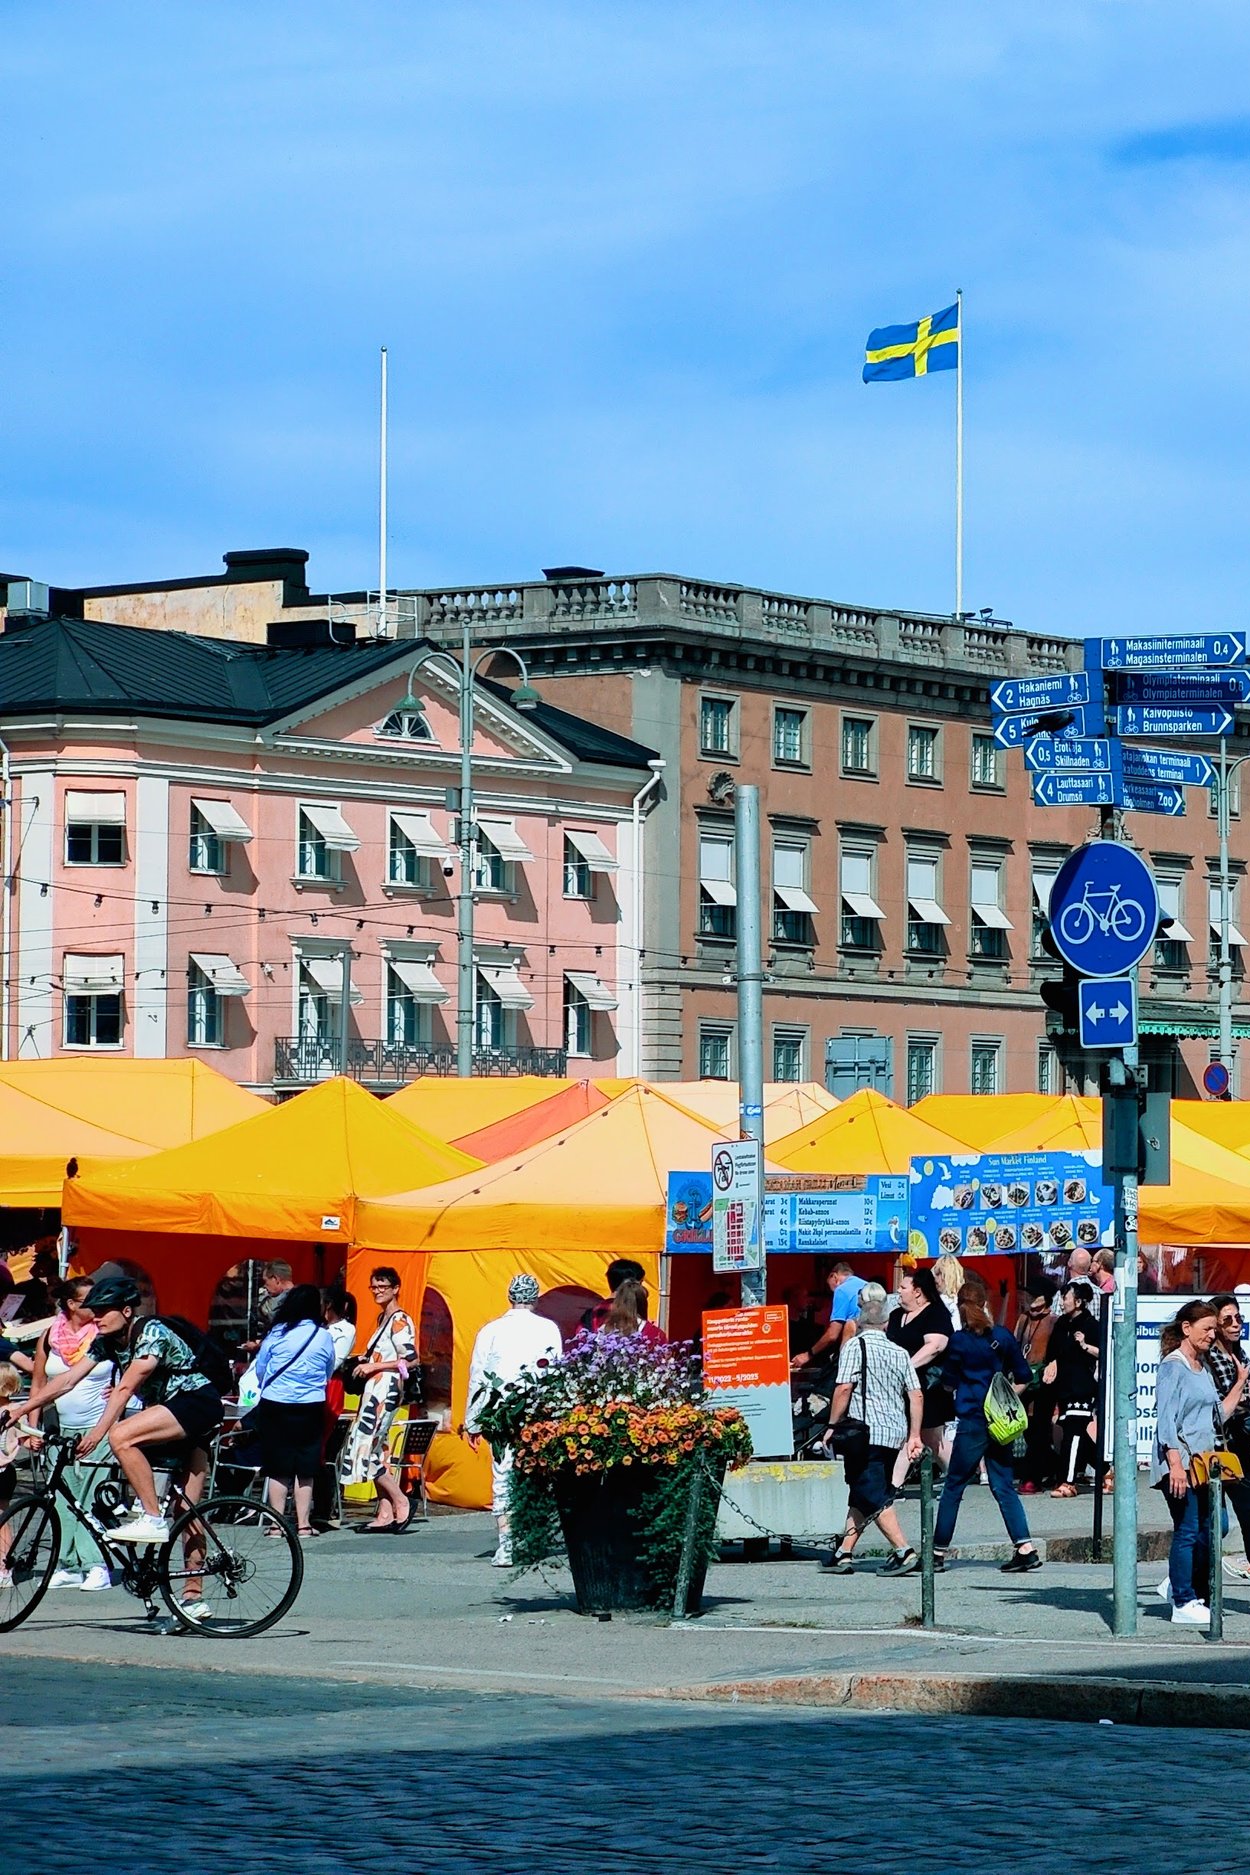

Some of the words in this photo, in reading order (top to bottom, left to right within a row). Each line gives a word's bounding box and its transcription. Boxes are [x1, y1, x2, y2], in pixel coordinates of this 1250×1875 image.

[1126, 637, 1205, 651] Makasiiniterminaali
[1214, 641, 1229, 656] 0,4
[1126, 653, 1208, 666] Magasinsterminalen
[1018, 678, 1063, 694] Hakaniemi
[1142, 674, 1221, 688] Olympiaterminaali
[1006, 689, 1014, 704] 2
[1019, 694, 1051, 708] Hagnäs
[1142, 687, 1223, 701] Olympiaterminalen
[1143, 707, 1194, 720] Kaivopuisto
[1211, 712, 1216, 726] 1
[1009, 725, 1016, 739] 5
[1143, 721, 1203, 734] Brunnsparken
[1038, 747, 1051, 763] 0,5
[1055, 755, 1091, 767] Skillnaden
[1122, 751, 1158, 765] atajanokan
[1159, 754, 1192, 768] terminaali
[1123, 765, 1156, 777] katuddens
[1157, 768, 1184, 780] terminal
[1195, 763, 1200, 777] 1
[1047, 782, 1054, 797] 4
[1056, 777, 1094, 789] Lauttasaari
[1057, 791, 1083, 802] Drumsö
[1157, 791, 1174, 808] Zoo
[988, 1157, 1000, 1166] Sun
[1000, 1156, 1023, 1165] Market
[1024, 1155, 1047, 1164] Finland
